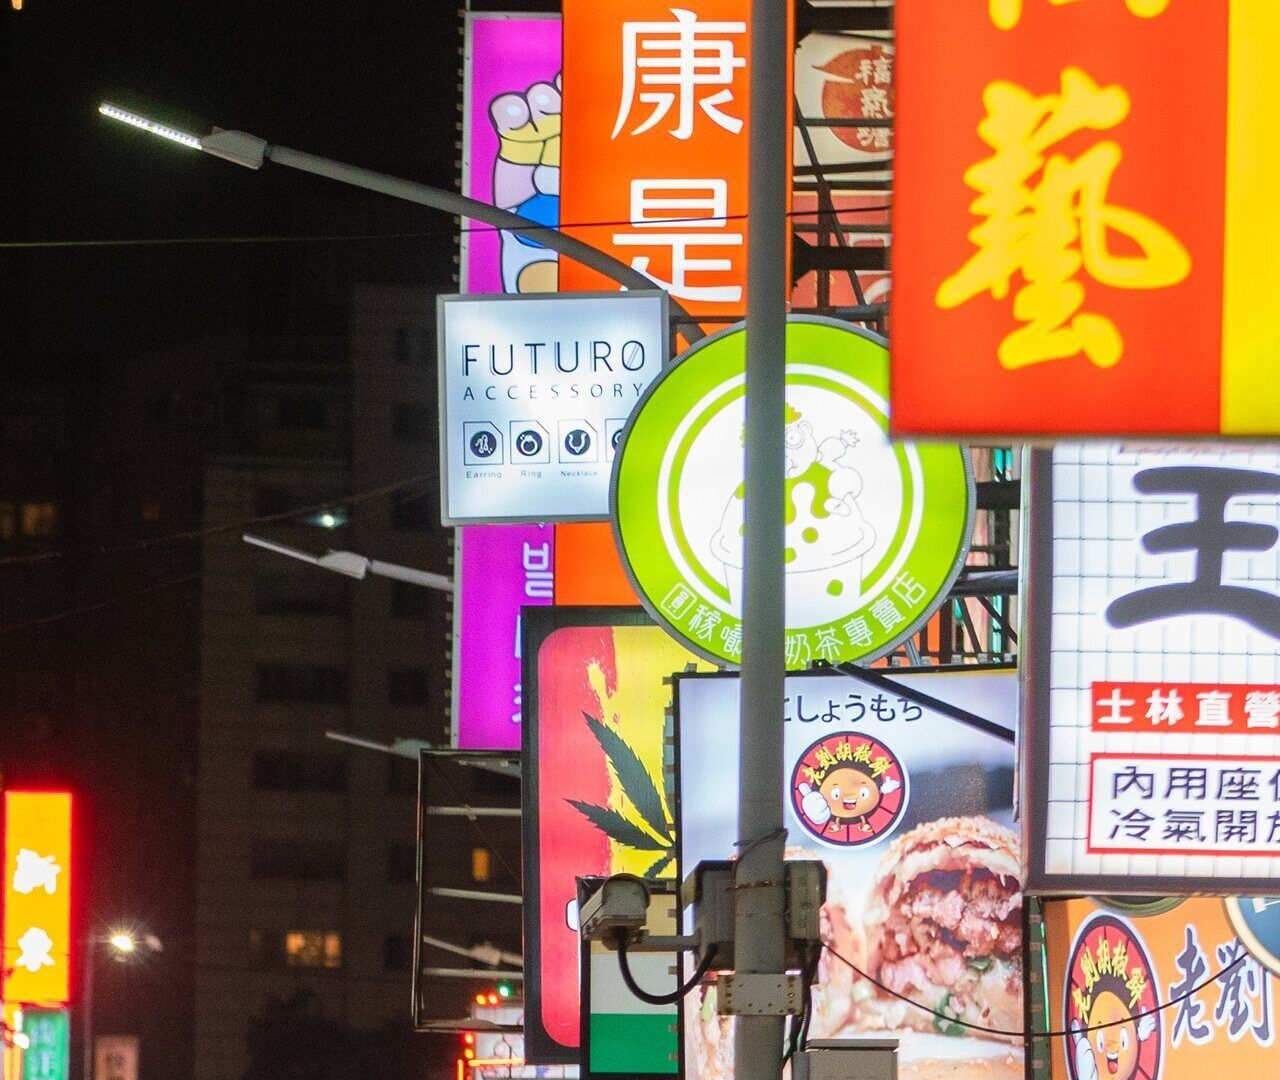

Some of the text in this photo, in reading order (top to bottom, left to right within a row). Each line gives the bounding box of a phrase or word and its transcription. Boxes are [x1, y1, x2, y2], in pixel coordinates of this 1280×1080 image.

[462, 339, 646, 377] FUTURO
[462, 381, 644, 401] ACCESSORY
[465, 470, 503, 479] Earring
[520, 470, 543, 479] Ring
